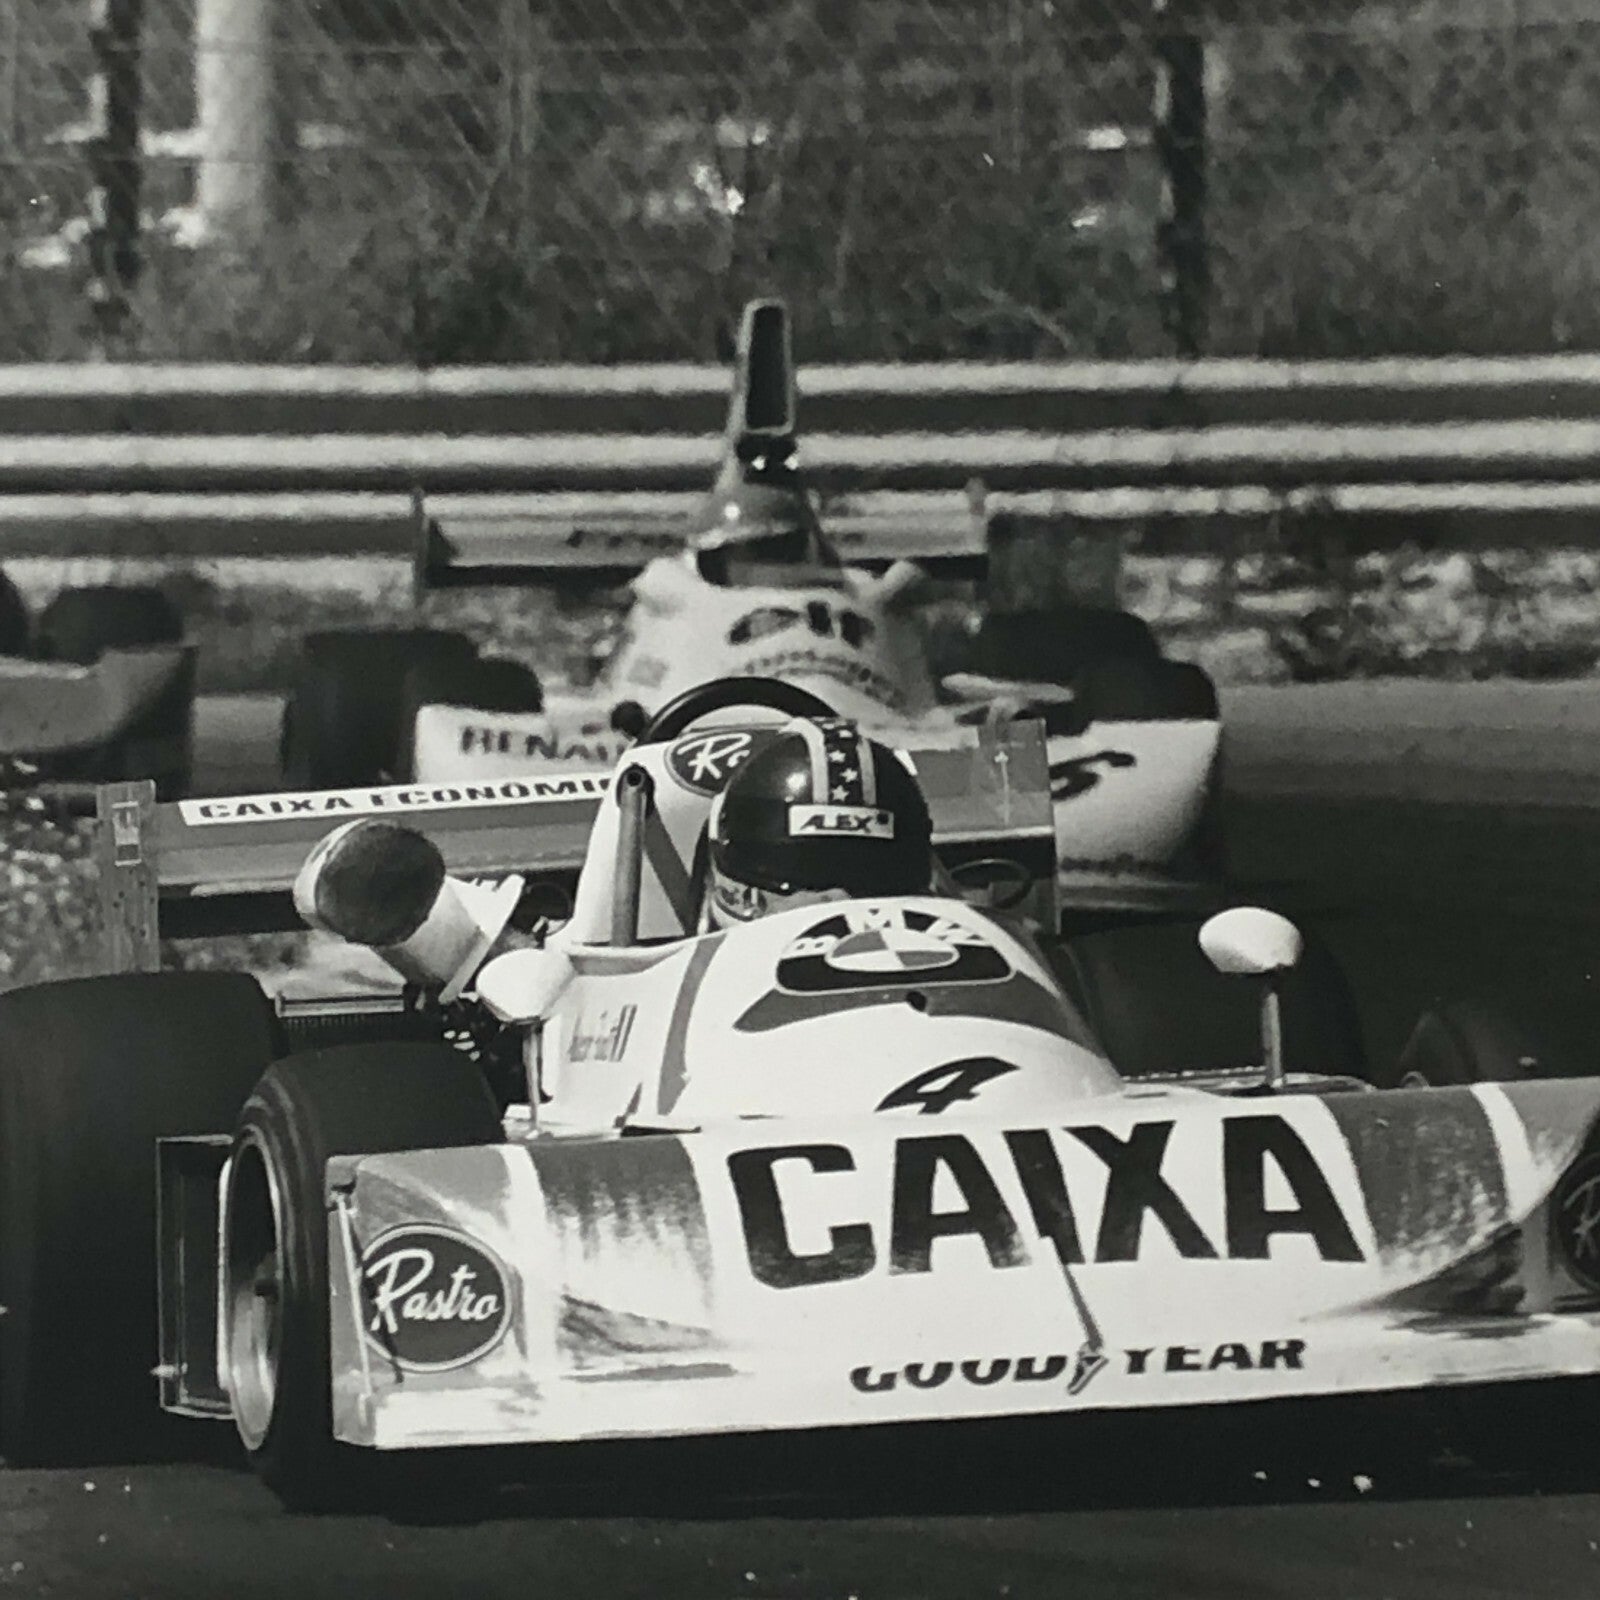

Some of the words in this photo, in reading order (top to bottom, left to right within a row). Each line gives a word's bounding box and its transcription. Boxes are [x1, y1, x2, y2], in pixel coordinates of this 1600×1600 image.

[199, 797, 353, 818] CAIXA
[800, 814, 874, 833] ALEX
[873, 1056, 1021, 1116] 4
[726, 1114, 1368, 1290] CAIXA
[366, 1248, 501, 1334] Rastro
[1122, 1338, 1307, 1375] YEAR
